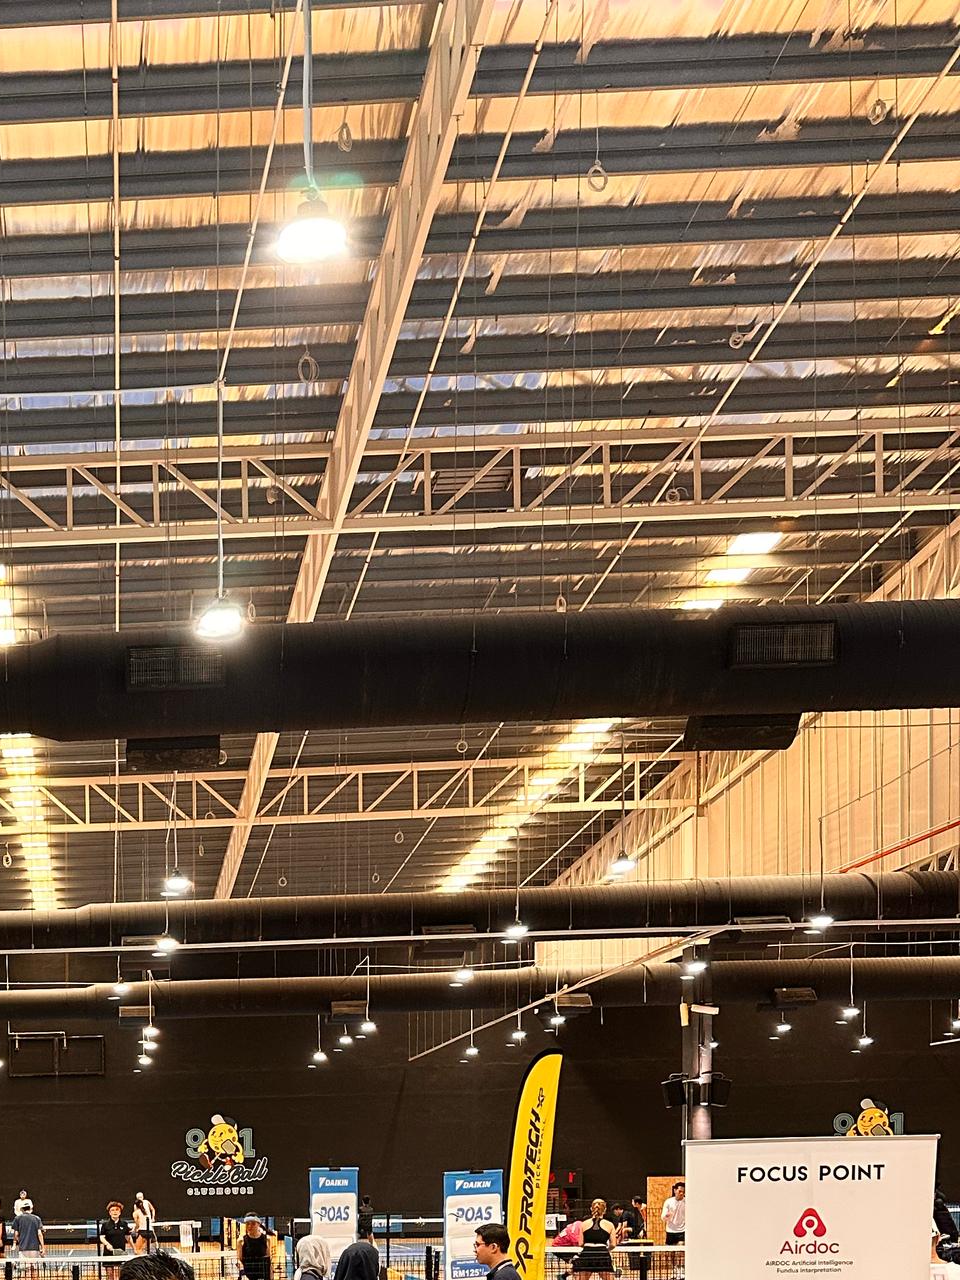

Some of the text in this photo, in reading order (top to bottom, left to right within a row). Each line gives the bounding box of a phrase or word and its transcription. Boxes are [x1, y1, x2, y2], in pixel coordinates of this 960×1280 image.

[519, 1107, 542, 1235] PROTECH
[737, 1163, 885, 1183] FOCUS POINT
[325, 1179, 349, 1187] DAIKIN
[462, 1180, 491, 1189] DAIKIN
[186, 1186, 254, 1196] CLUBHOUSE
[320, 1206, 350, 1221] POAS
[456, 1206, 493, 1222] POAS
[779, 1240, 840, 1255] Airdoc
